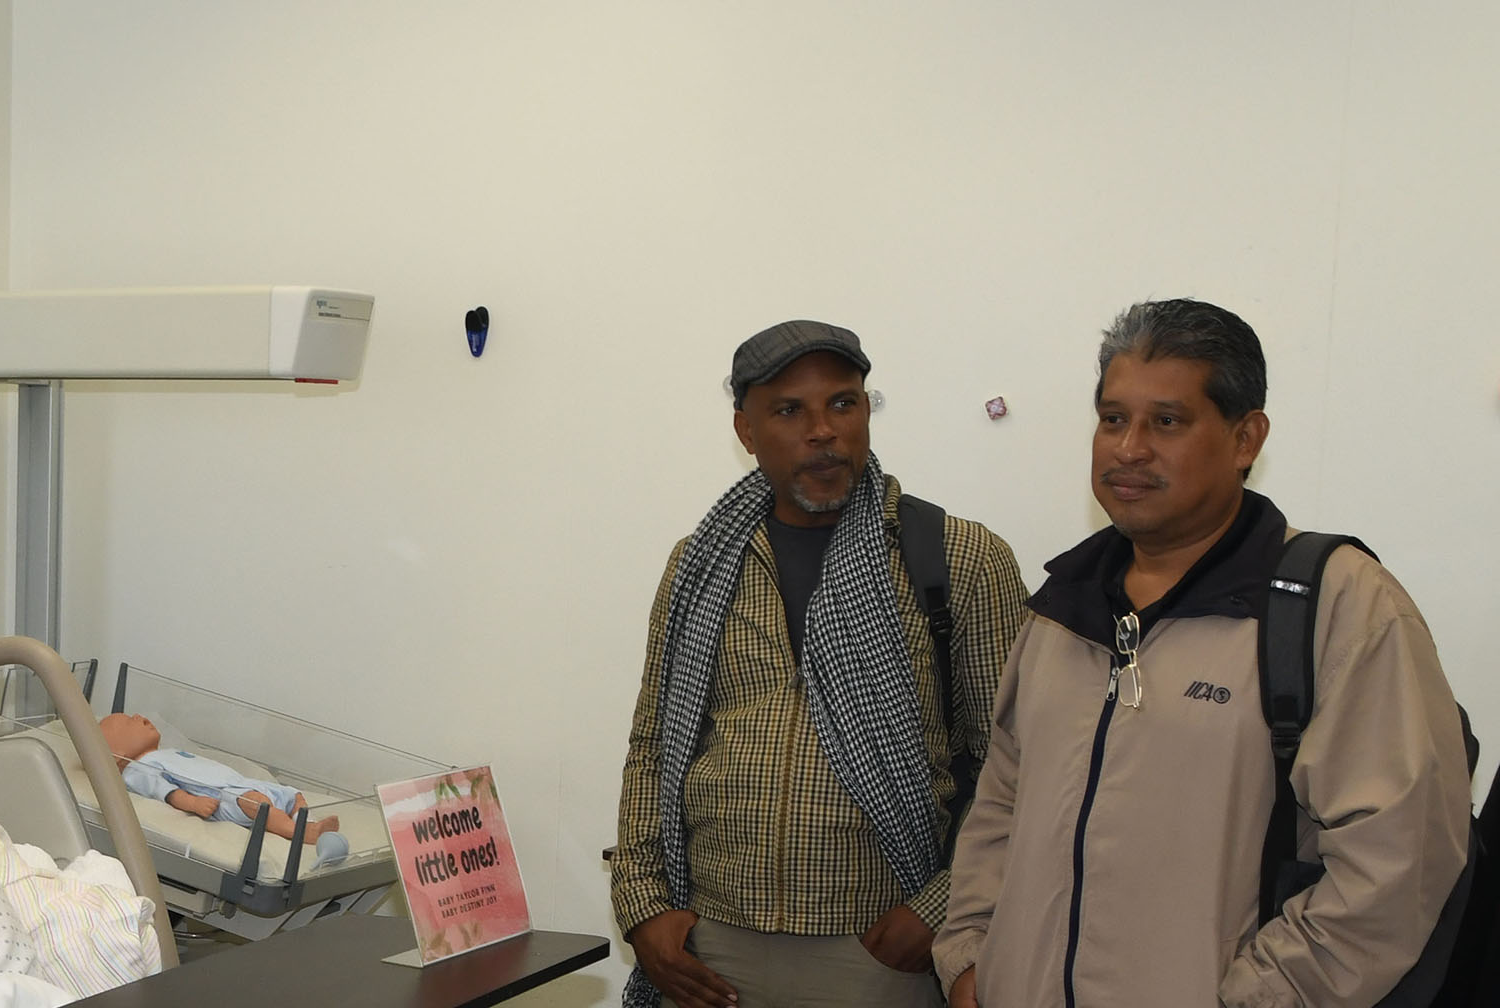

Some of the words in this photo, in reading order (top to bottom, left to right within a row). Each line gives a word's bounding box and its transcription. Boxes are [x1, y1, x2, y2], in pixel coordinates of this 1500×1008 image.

[413, 806, 482, 844] welcome
[414, 849, 458, 887] little
[461, 836, 500, 874] ones!
[438, 896, 454, 907] BABY
[456, 888, 480, 901] TAYLOR
[442, 907, 458, 918] BABY
[460, 899, 484, 913] DESTINY
[486, 896, 498, 906] JOY
